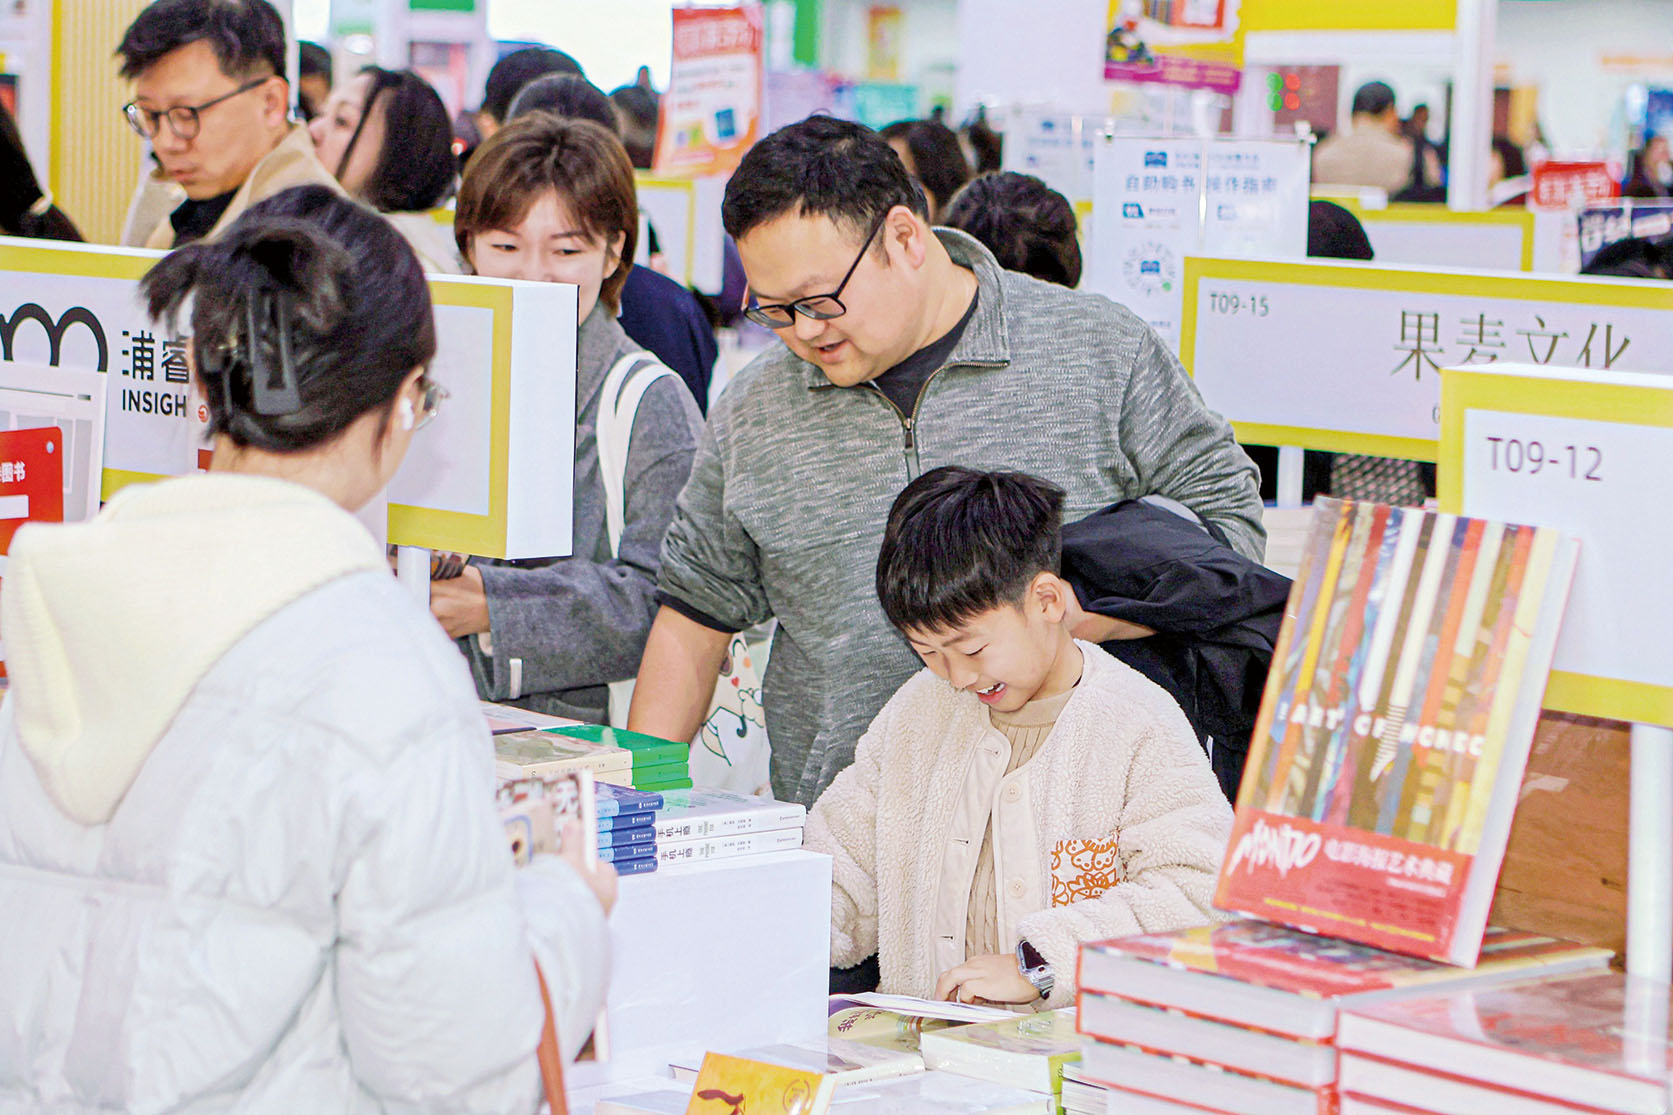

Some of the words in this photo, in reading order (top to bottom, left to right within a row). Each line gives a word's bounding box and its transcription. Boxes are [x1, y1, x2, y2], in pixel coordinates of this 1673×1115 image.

[1209, 292, 1269, 318] T09-15
[122, 329, 190, 384] 浦睿
[122, 388, 187, 418] INSIGH
[0, 460, 26, 482] 图书
[1486, 436, 1603, 482] T09-12
